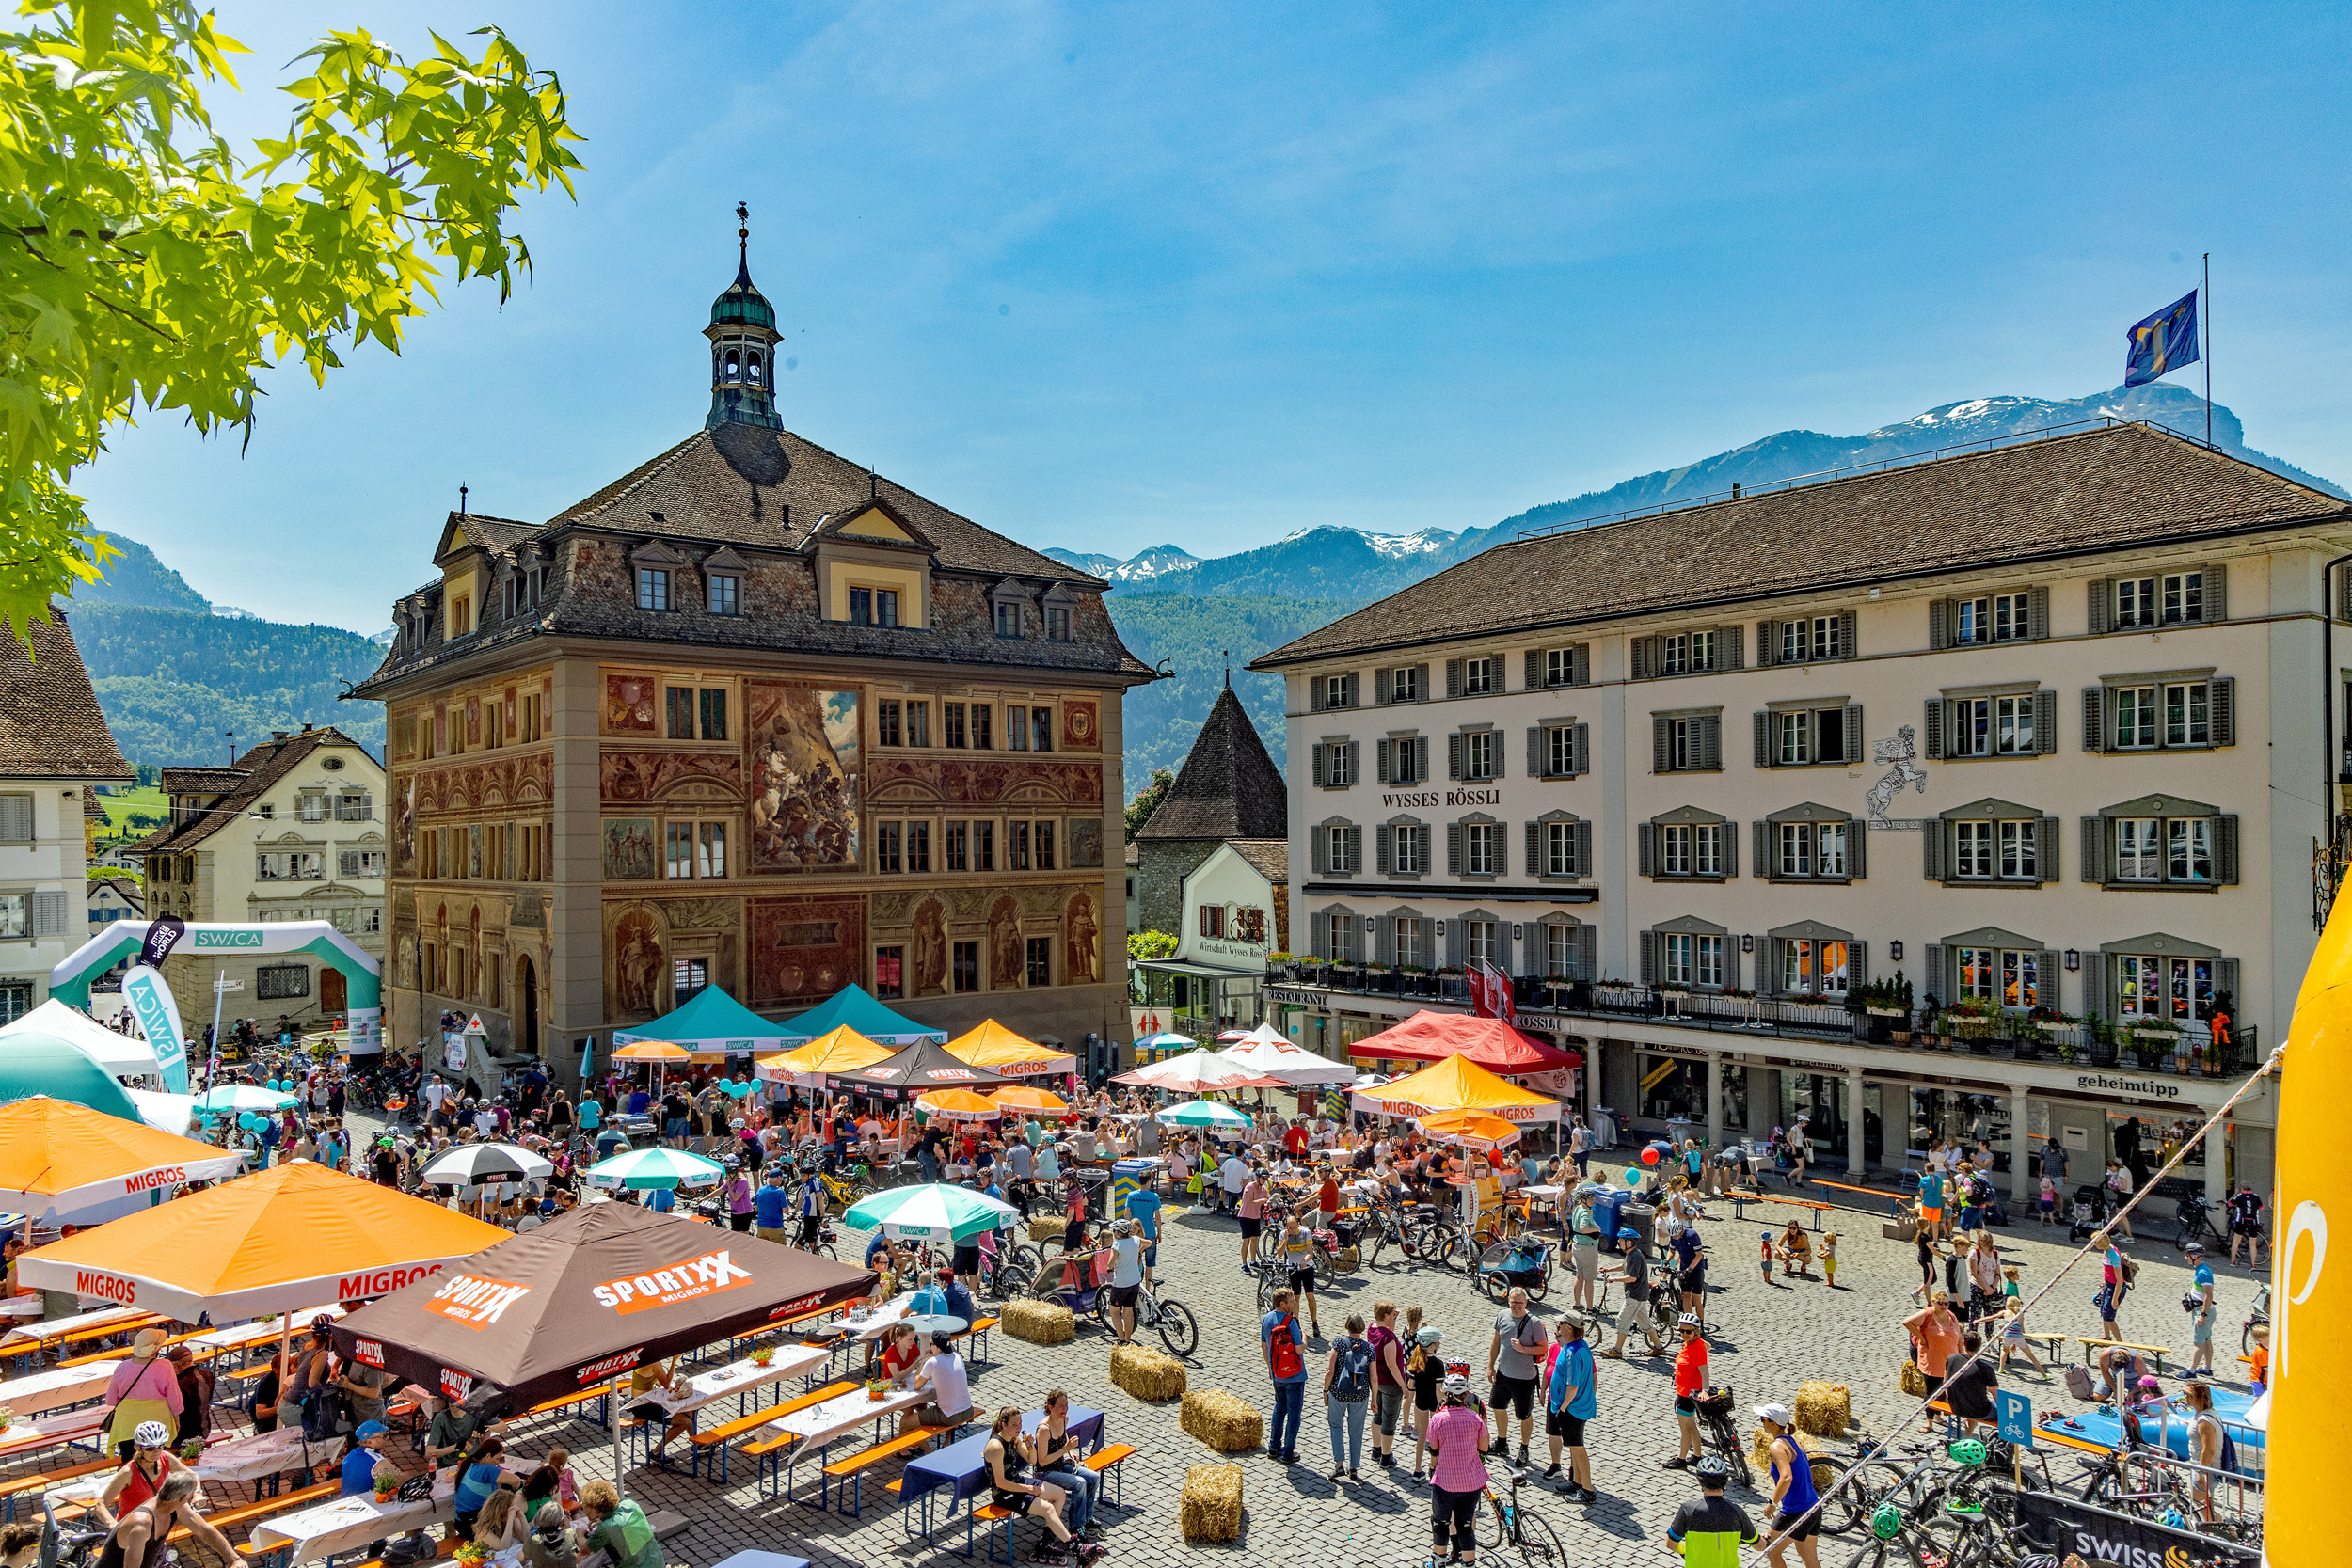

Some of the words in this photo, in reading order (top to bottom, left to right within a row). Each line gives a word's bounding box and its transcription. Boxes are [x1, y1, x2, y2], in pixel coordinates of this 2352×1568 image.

[1383, 792, 1438, 808] WYSSES
[1446, 788, 1500, 806] RÖSSLI
[152, 930, 177, 959] WORLD
[1199, 942, 1227, 955] Wirtschaft
[1229, 944, 1248, 958] Wysses
[1268, 990, 1327, 1005] RESTAURANT
[727, 1040, 753, 1049] SWICA
[769, 1069, 796, 1082] MIGROS
[1001, 1061, 1048, 1076] MIGROS
[1641, 1060, 1677, 1091] Neueröffnung
[2077, 1074, 2179, 1098] geheimtipp
[1381, 1101, 1432, 1117] MIGROS
[1493, 1107, 1535, 1120] MIGROS
[1463, 1139, 1487, 1148] MIGROS
[1501, 1135, 1517, 1146] MIGROS
[126, 1166, 186, 1193] MIGROS
[901, 1226, 929, 1235] SWICA
[77, 1272, 135, 1304] MIGROS
[660, 1284, 709, 1304] MIGROS
[443, 1305, 472, 1320] MIGROS
[598, 1365, 619, 1376] MIGROS
[2008, 1398, 2023, 1419] P
[2075, 1532, 2162, 1568] SWISS
